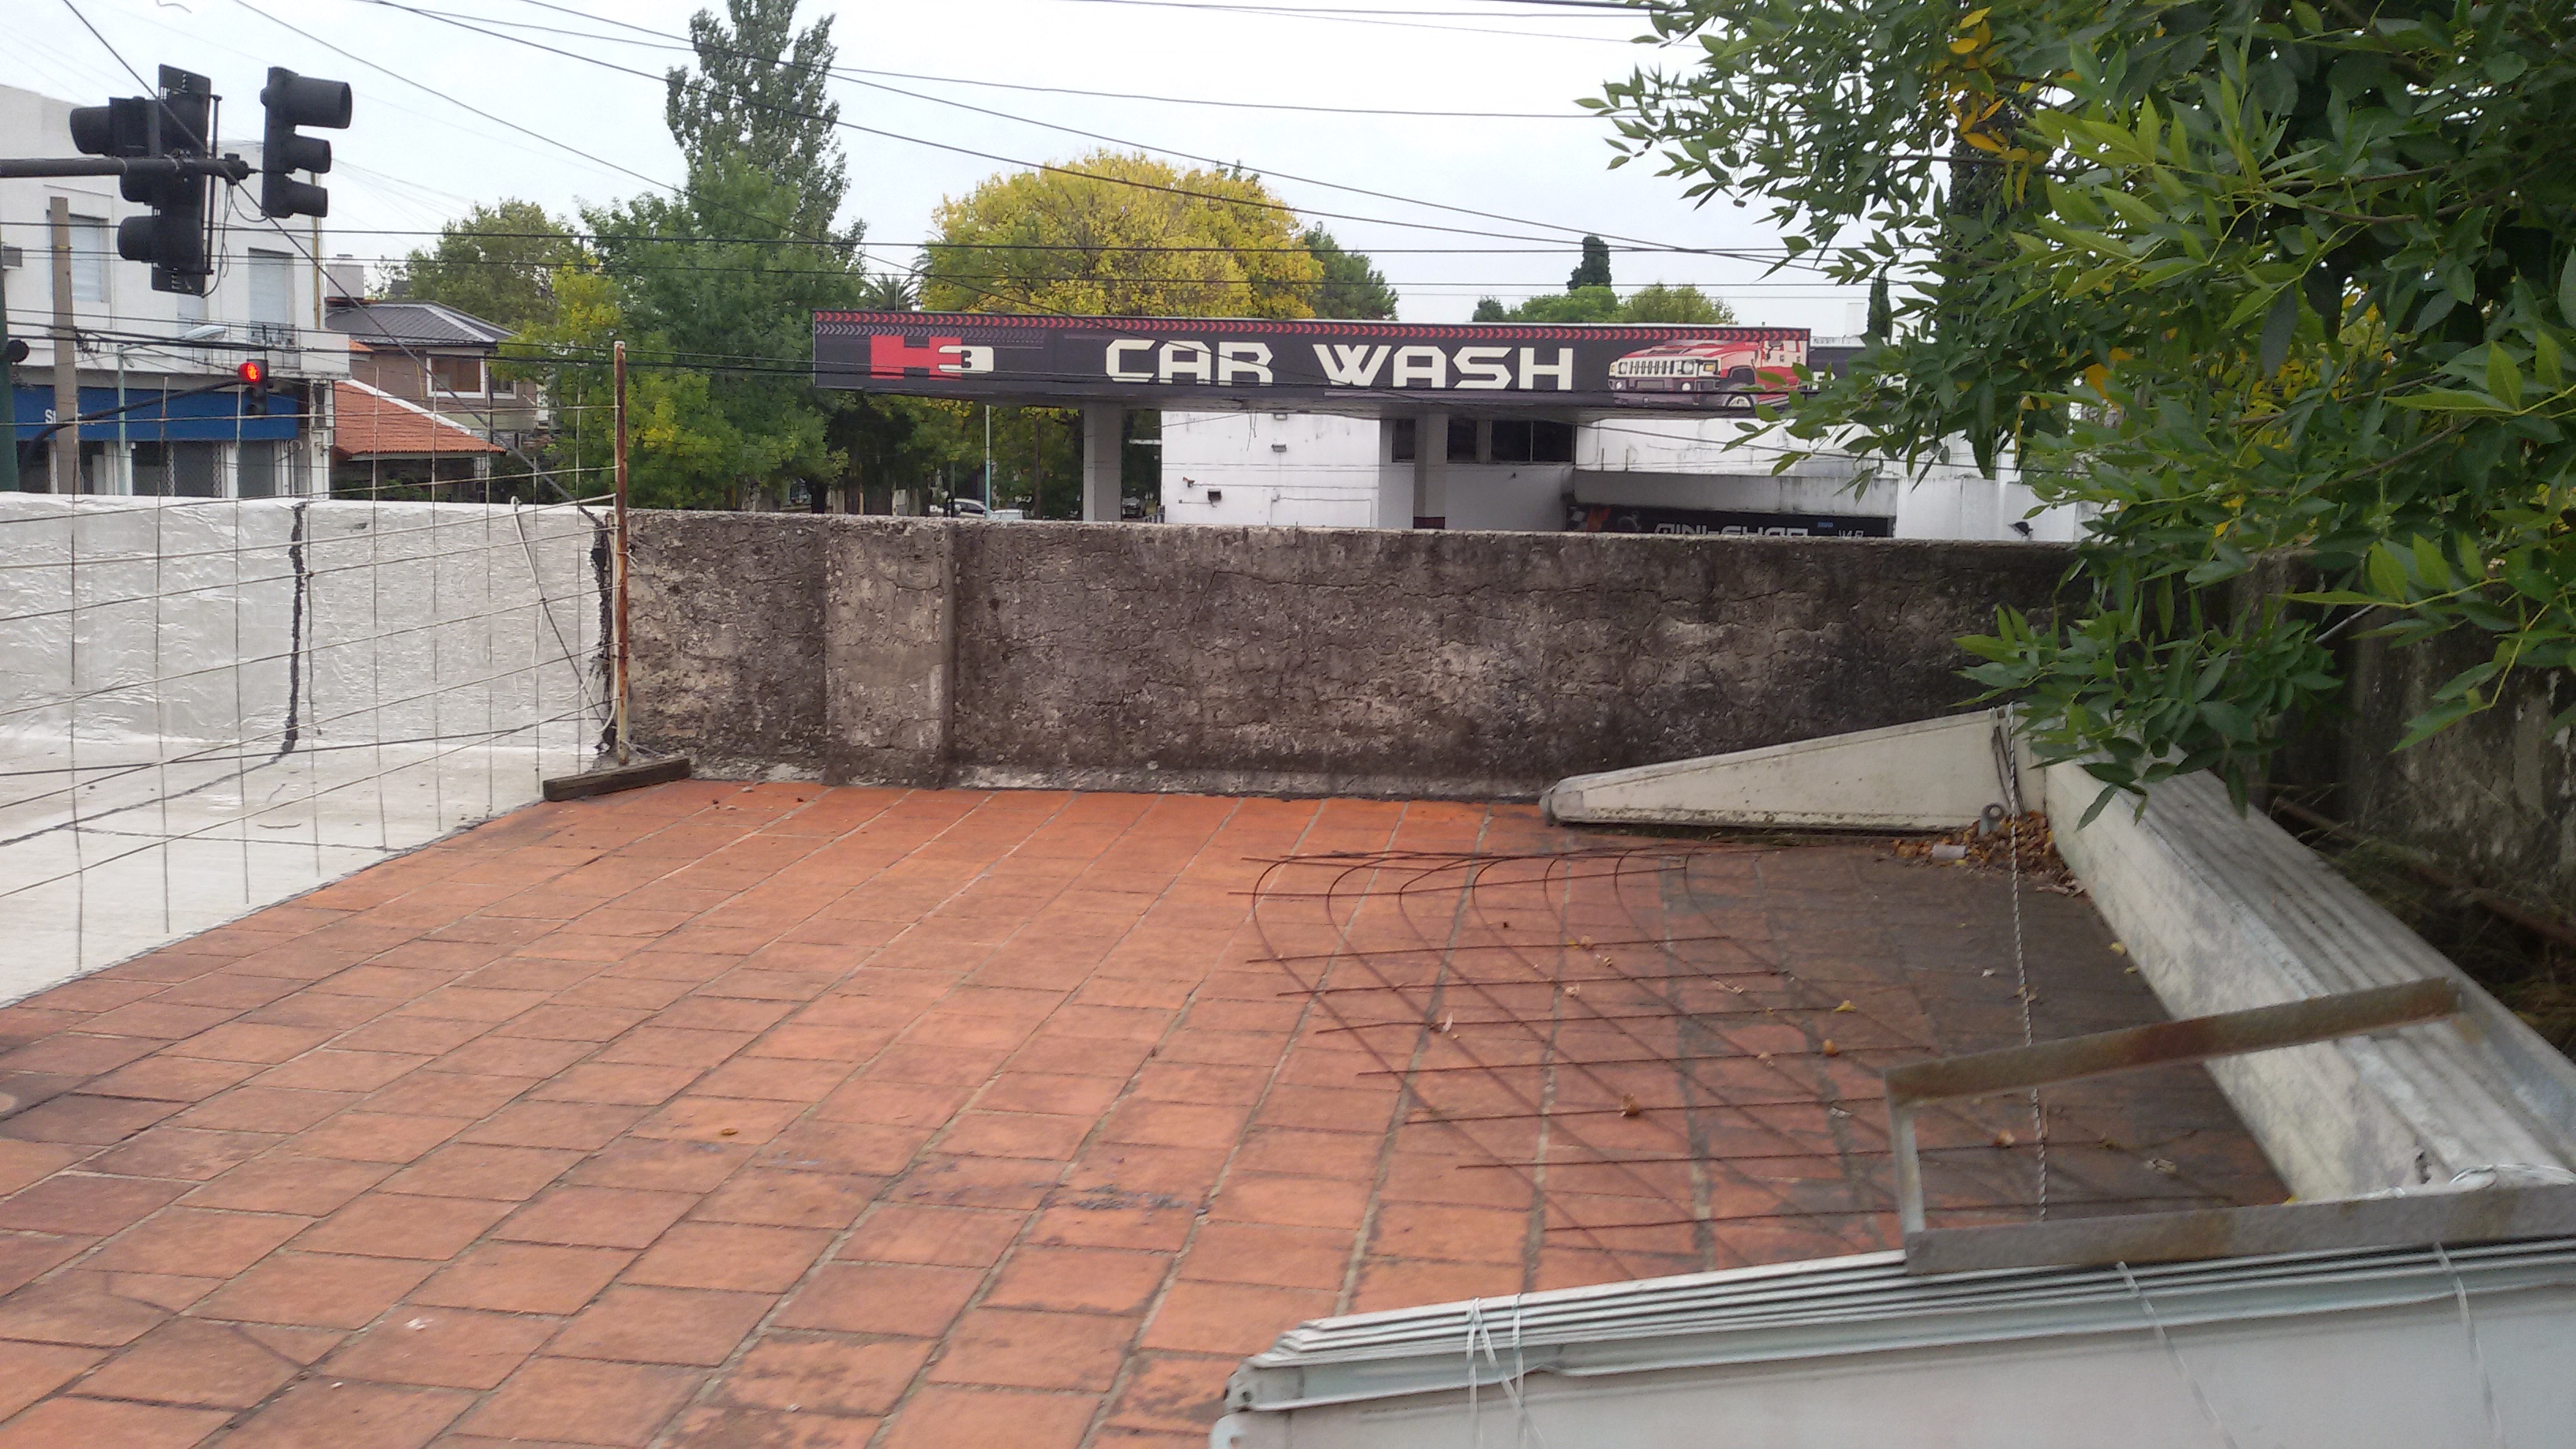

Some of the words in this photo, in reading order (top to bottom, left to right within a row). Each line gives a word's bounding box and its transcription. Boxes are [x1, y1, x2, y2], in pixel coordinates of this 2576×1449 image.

[871, 335, 994, 380] H3
[1106, 339, 1273, 387] CAR
[1312, 343, 1574, 391] WASH
